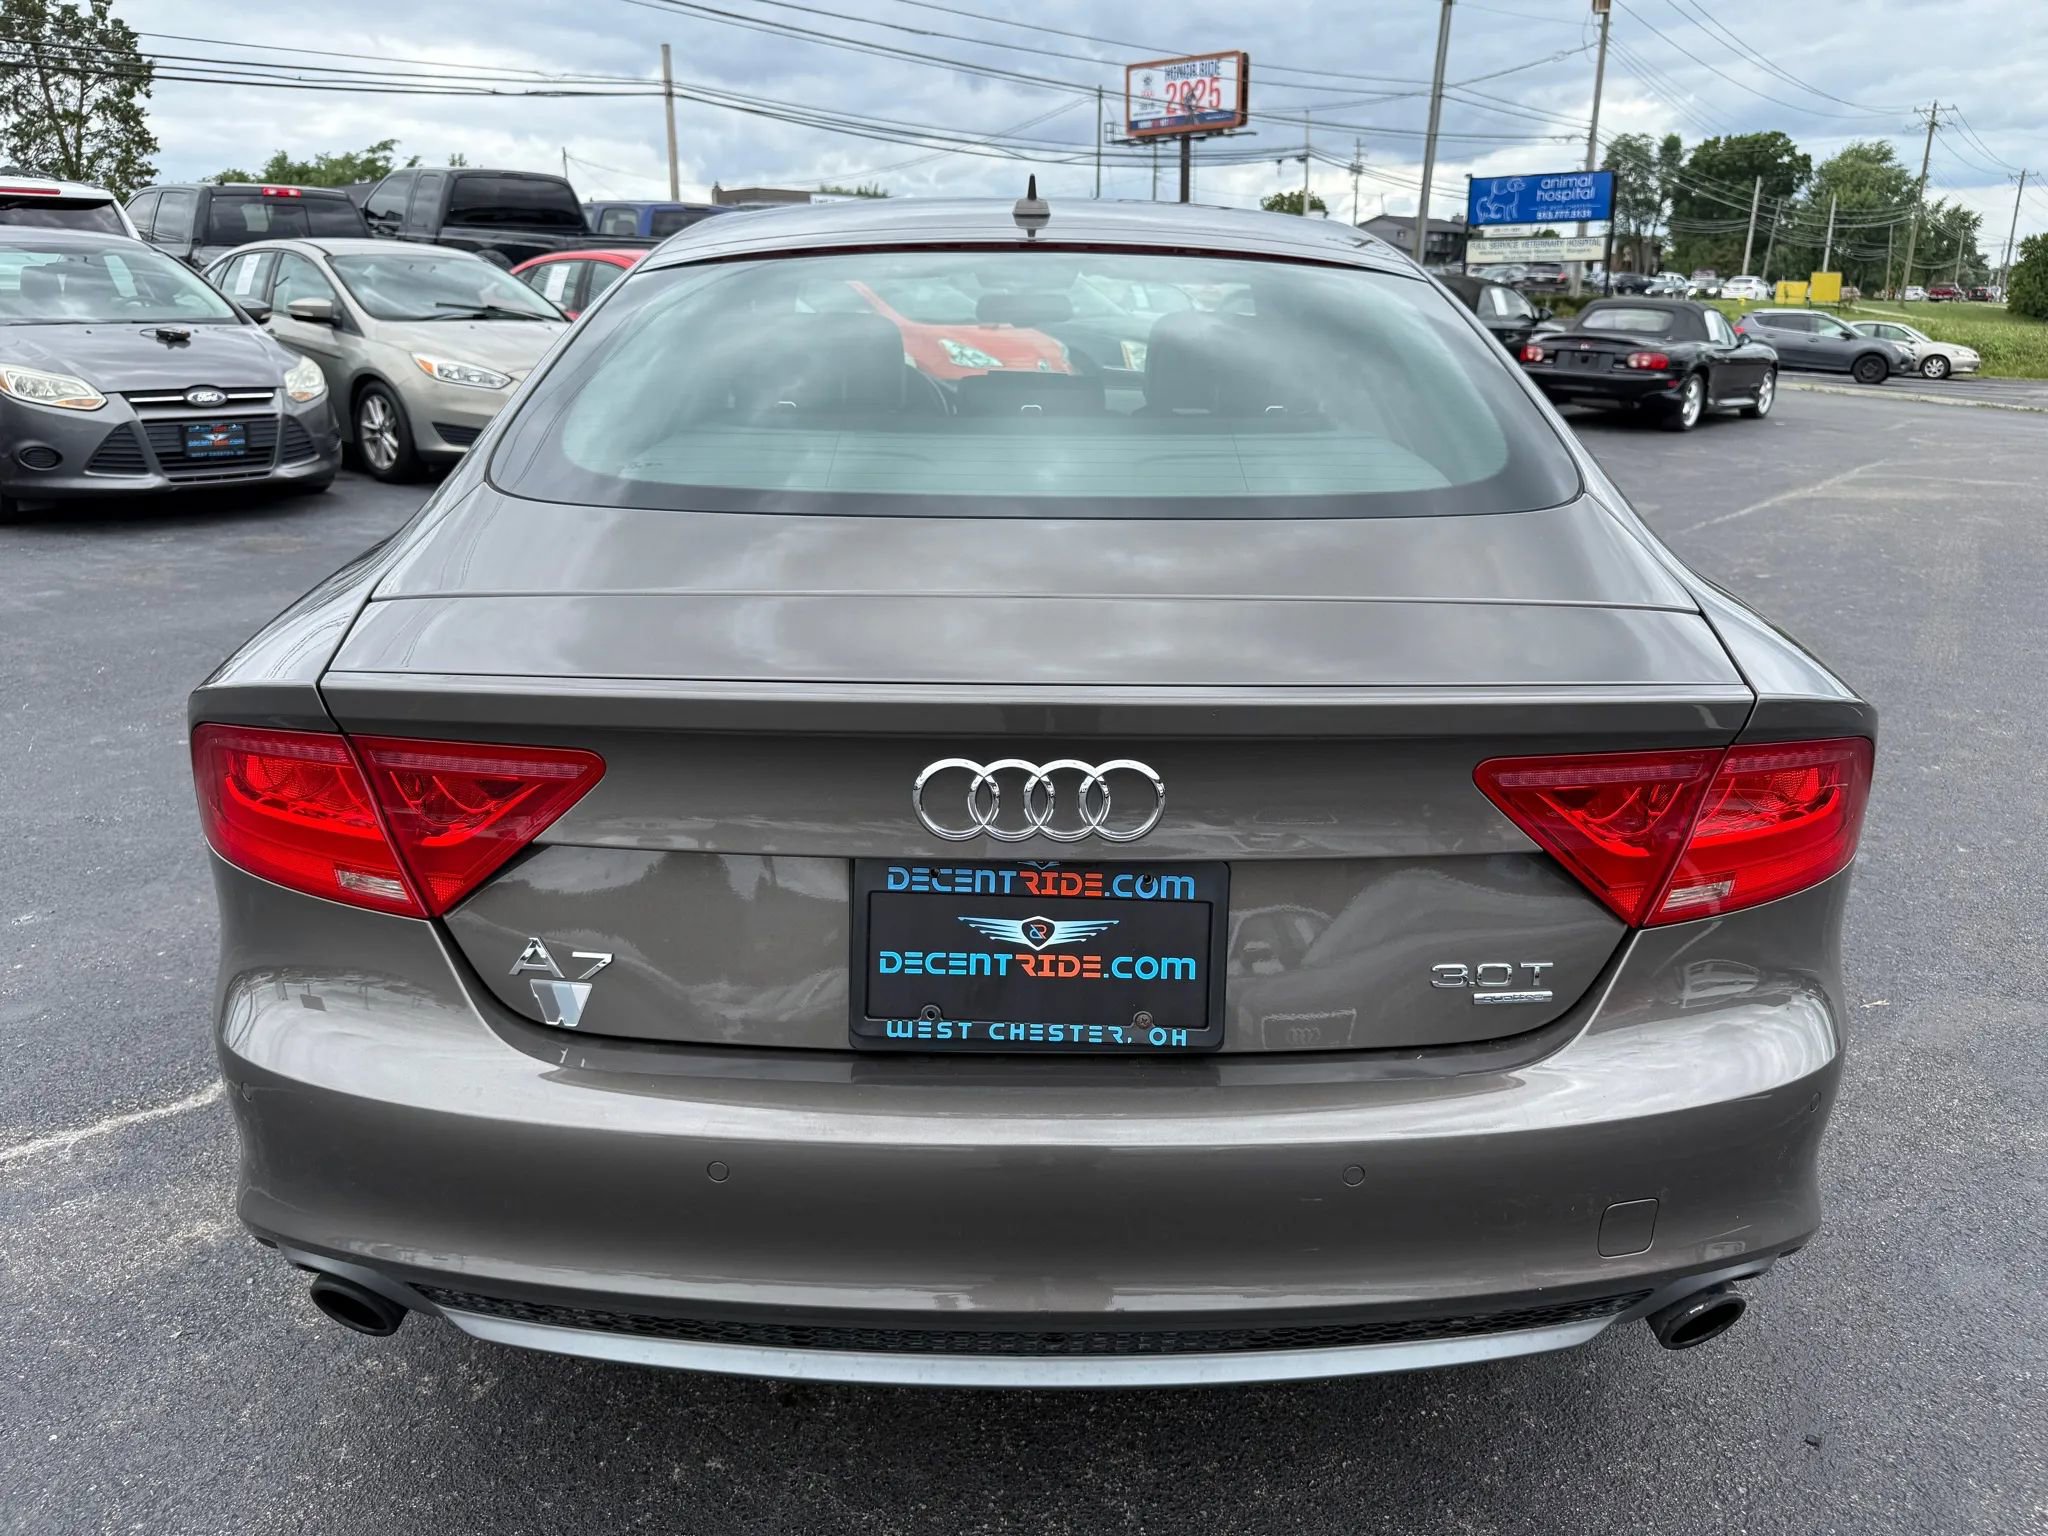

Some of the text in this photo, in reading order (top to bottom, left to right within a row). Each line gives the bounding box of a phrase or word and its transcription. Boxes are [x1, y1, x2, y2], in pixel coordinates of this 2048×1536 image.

[1165, 76, 1222, 116] 2025
[1540, 173, 1594, 190] animal
[1536, 186, 1596, 203] hospital
[1469, 238, 1602, 250] FULL SERVICE VETERINARY HOSPITAL
[196, 391, 219, 402] Ford
[1482, 992, 1544, 1004] quattro
[886, 1019, 1188, 1048] WEST CHESTER, OH
